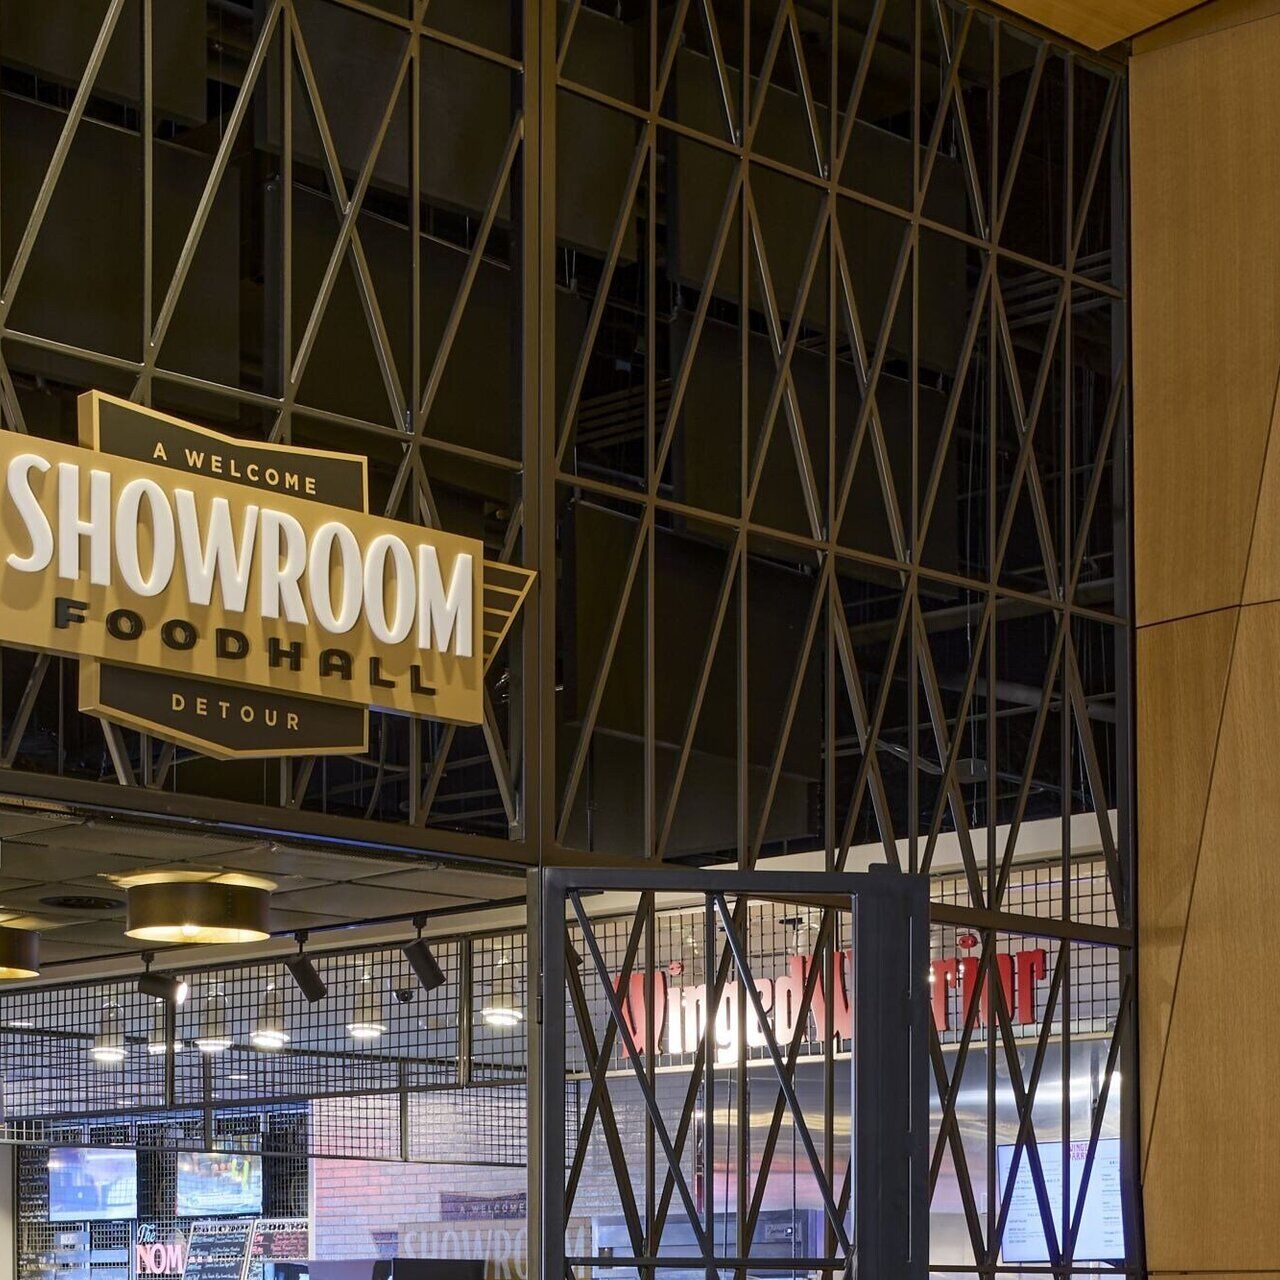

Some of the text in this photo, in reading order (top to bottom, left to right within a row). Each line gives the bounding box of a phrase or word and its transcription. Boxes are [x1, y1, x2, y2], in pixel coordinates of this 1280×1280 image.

[153, 441, 317, 495] A WELCOME
[5, 453, 474, 658] SHOWROOM
[54, 596, 437, 697] FOODHALL
[171, 693, 300, 731] DETOUR
[471, 1202, 527, 1214] WELCOME
[137, 1224, 158, 1244] The
[136, 1242, 184, 1274] NOM
